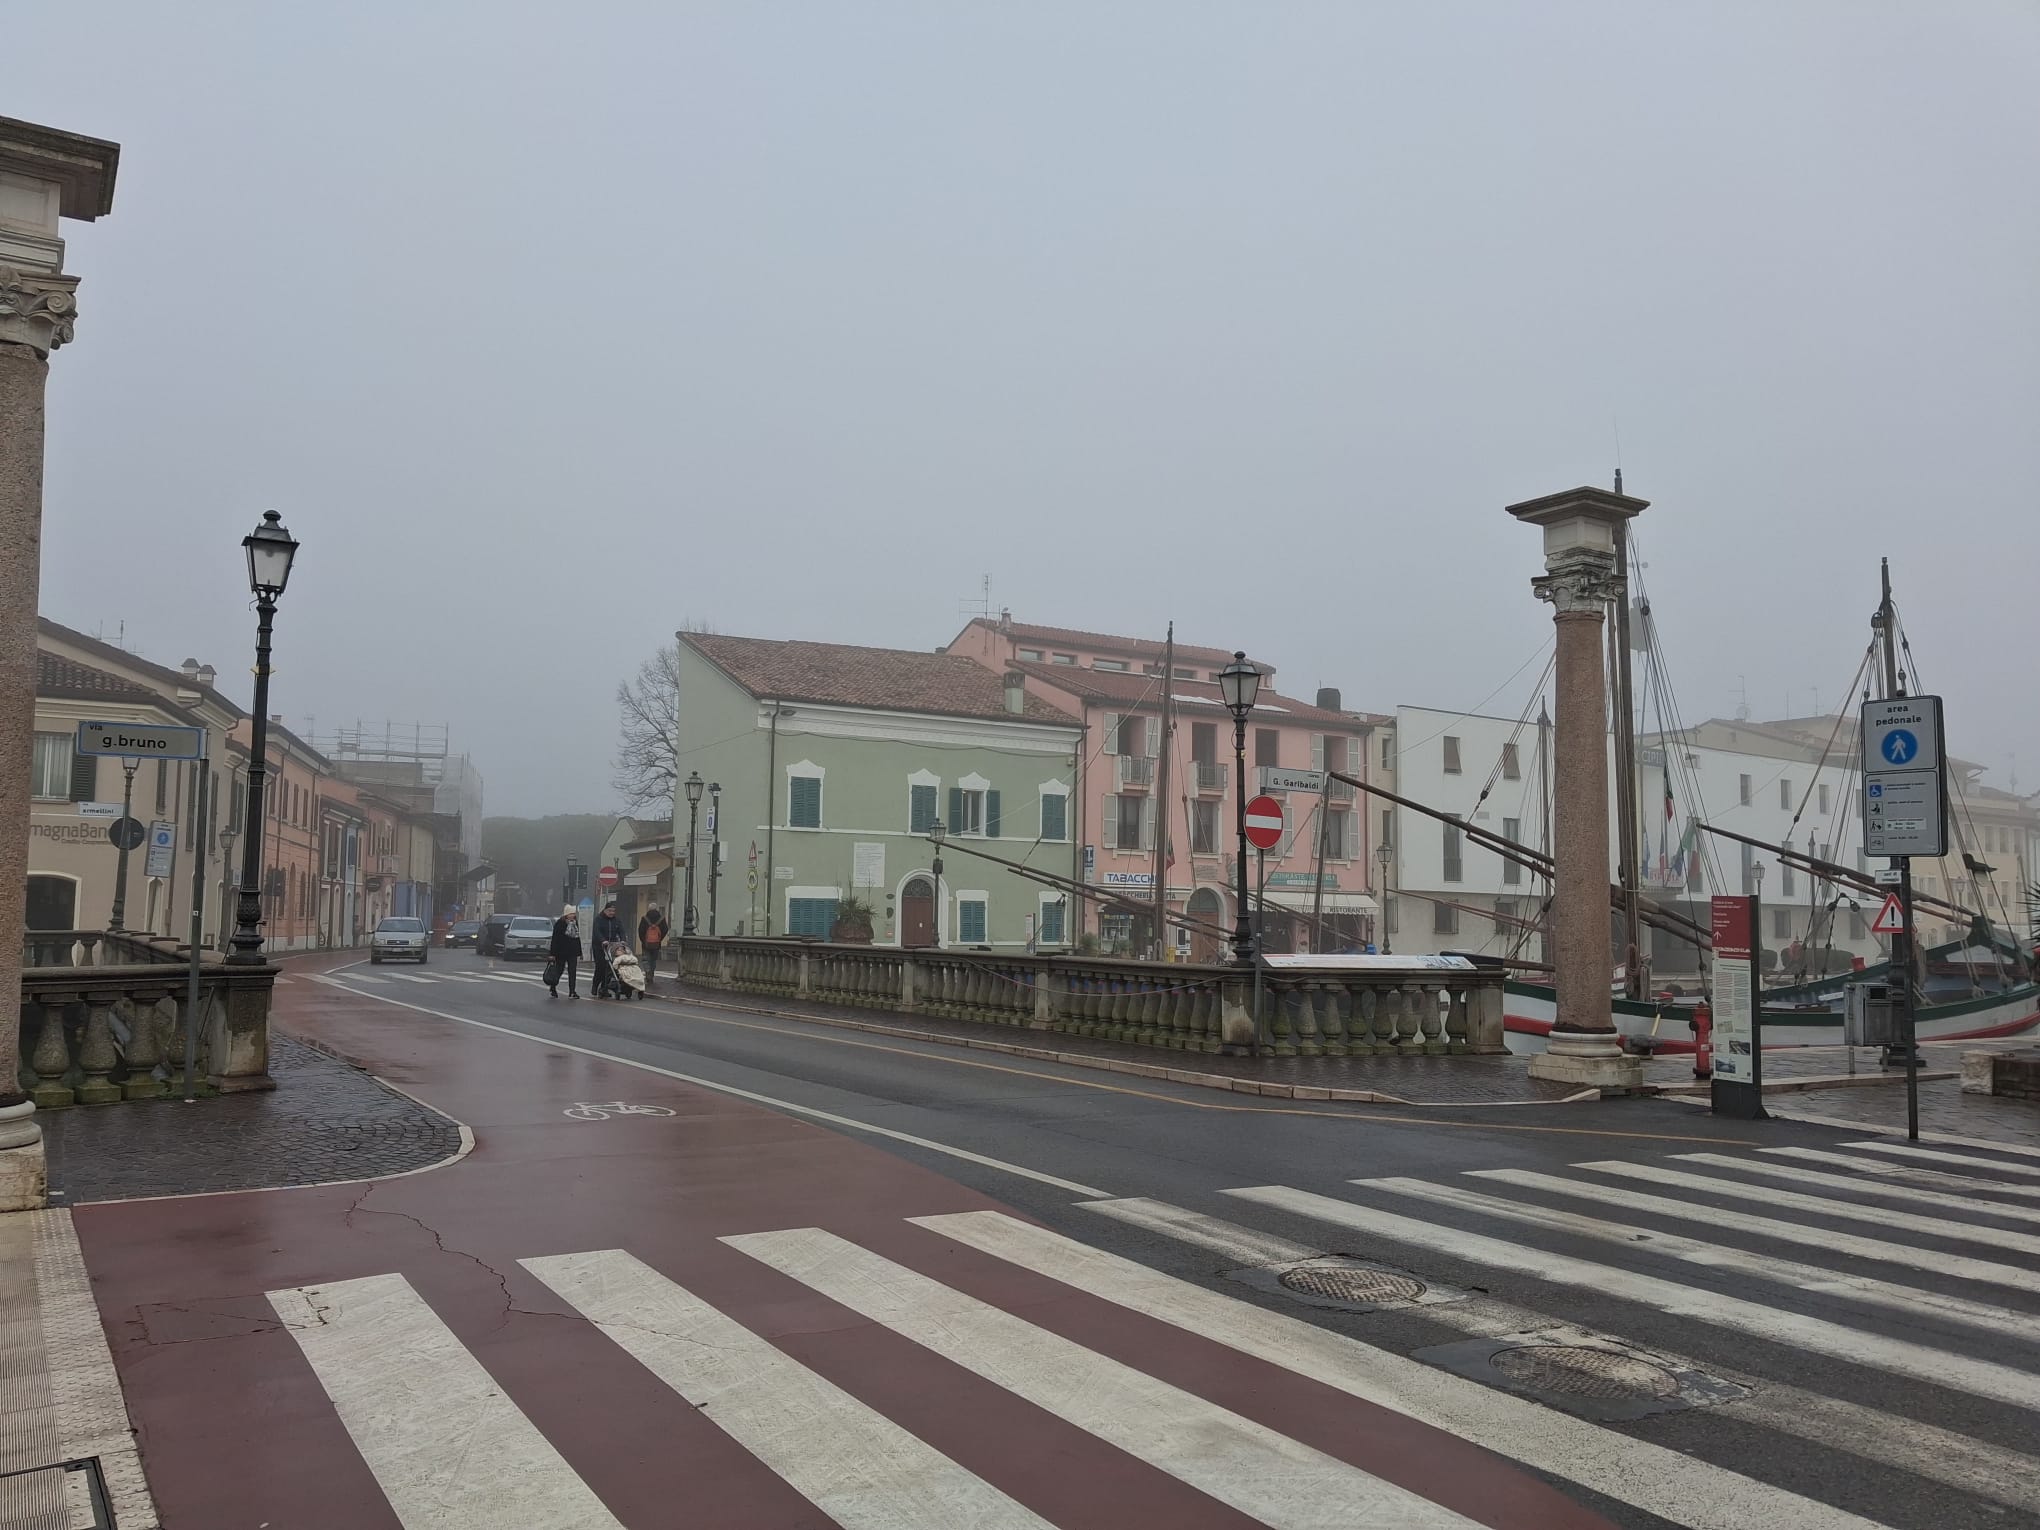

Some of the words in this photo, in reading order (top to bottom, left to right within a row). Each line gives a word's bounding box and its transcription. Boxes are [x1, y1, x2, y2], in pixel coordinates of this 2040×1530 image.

[1887, 705, 1908, 713] area
[1876, 715, 1922, 727] pedonale
[102, 734, 167, 749] g.bruno
[1272, 777, 1280, 786] G.
[1283, 779, 1319, 790] Garibaldi
[30, 822, 107, 841] magnaBan
